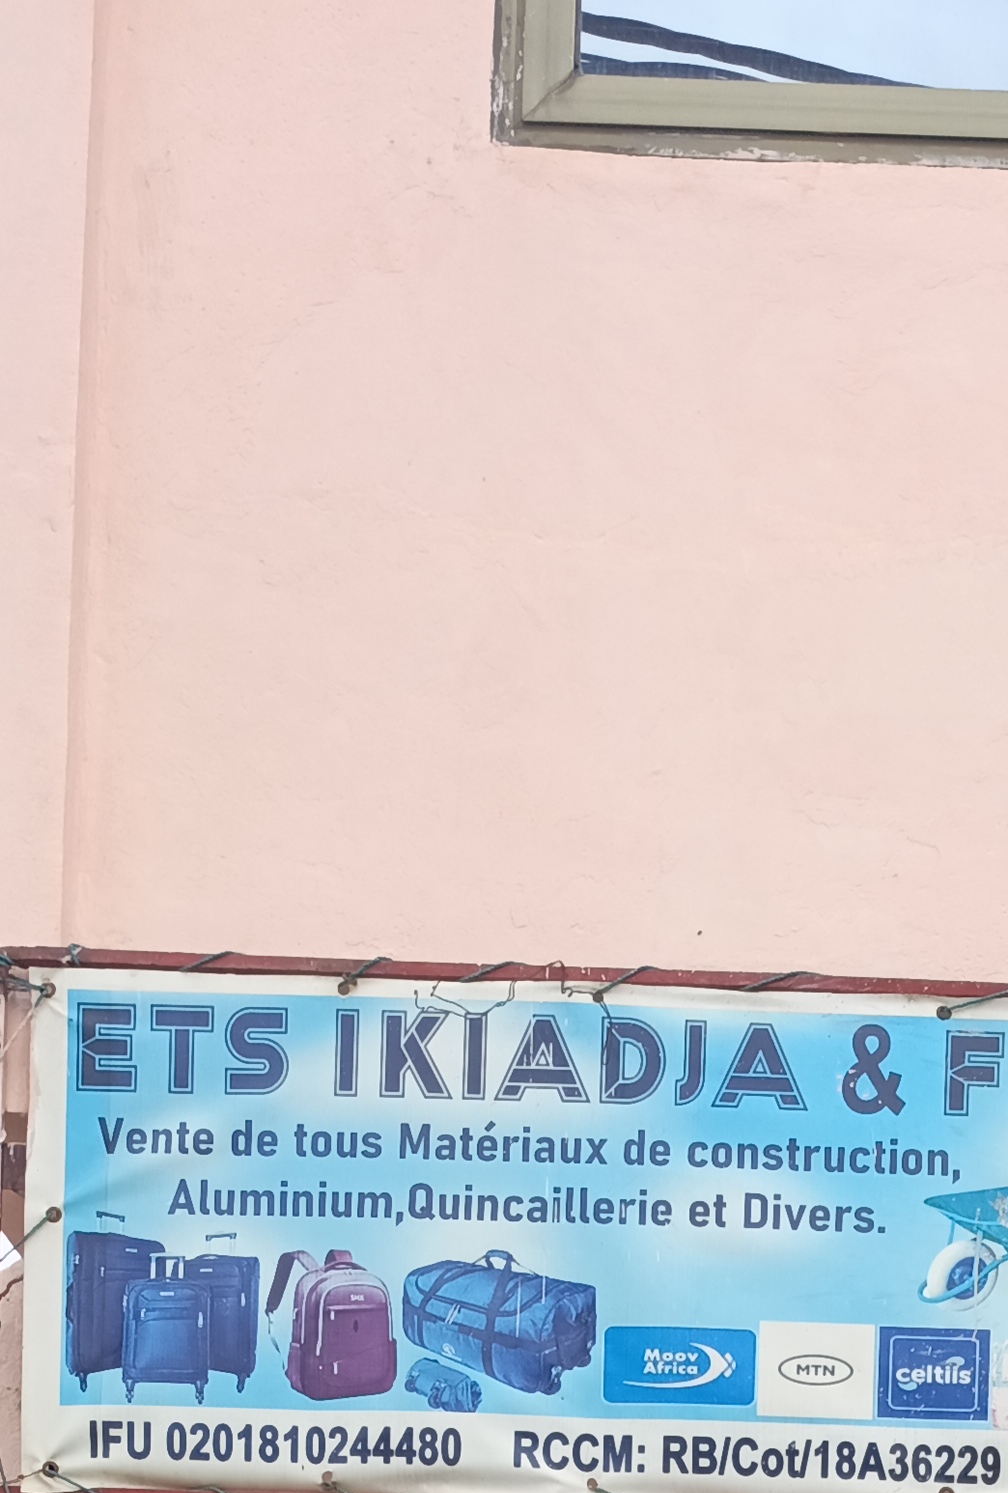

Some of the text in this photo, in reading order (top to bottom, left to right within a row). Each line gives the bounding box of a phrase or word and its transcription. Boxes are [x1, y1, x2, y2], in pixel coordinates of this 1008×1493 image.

[75, 1002, 288, 1095] ETS
[334, 1007, 808, 1112] IKIADJA
[841, 1024, 906, 1115] &
[98, 1117, 961, 1183] Vente de tous Matériaux de construction,
[168, 1179, 887, 1235] Aluminium,Quincaillerie et Divers.
[642, 1361, 699, 1376] Africa
[643, 1348, 698, 1363] Moov
[795, 1363, 836, 1377] MTN
[895, 1362, 972, 1382] celtiis
[89, 1420, 151, 1459] IFU
[165, 1421, 462, 1466] 0201810244480
[512, 1430, 647, 1473] RCCM:
[661, 1436, 1001, 1485] RB/Cot/18A36229
